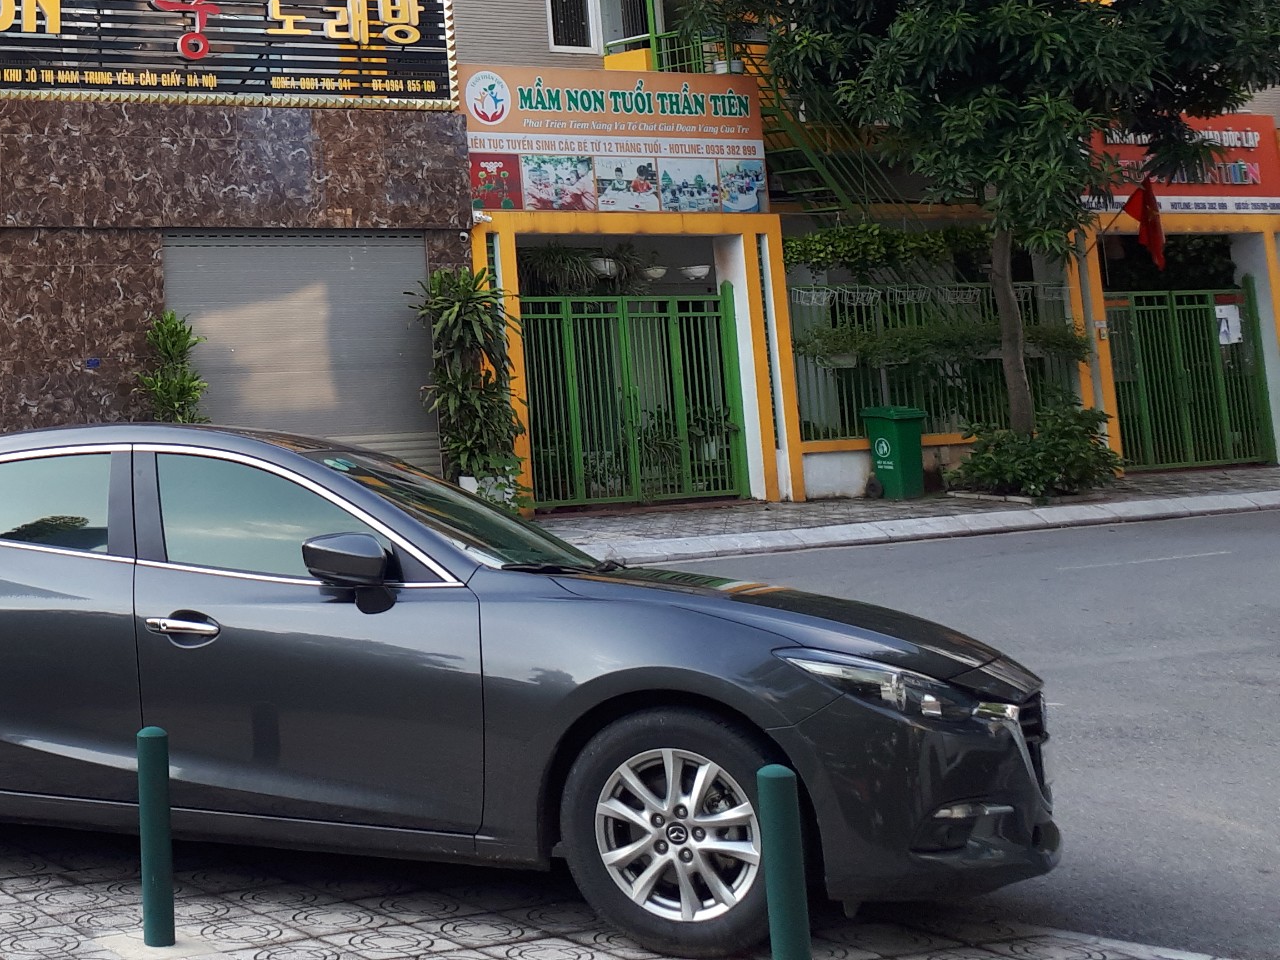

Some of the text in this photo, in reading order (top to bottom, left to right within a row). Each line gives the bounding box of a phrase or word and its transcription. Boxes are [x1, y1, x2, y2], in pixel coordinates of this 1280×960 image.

[4, 68, 22, 82] KHU
[41, 69, 54, 85] THỊ
[57, 70, 80, 84] NAM
[84, 70, 113, 85] TRUNG
[187, 72, 199, 87] HÀ
[202, 72, 217, 90] NỘI
[517, 76, 750, 118] MẦM NON TUỔI THẦN TIÊN
[487, 138, 504, 152] TỤC
[536, 139, 557, 151] SINH
[558, 138, 576, 152] CÁC
[577, 139, 589, 152] BÉ
[603, 142, 613, 153] 12
[615, 140, 642, 154] THÁNG
[669, 143, 704, 155] HOTLINE:
